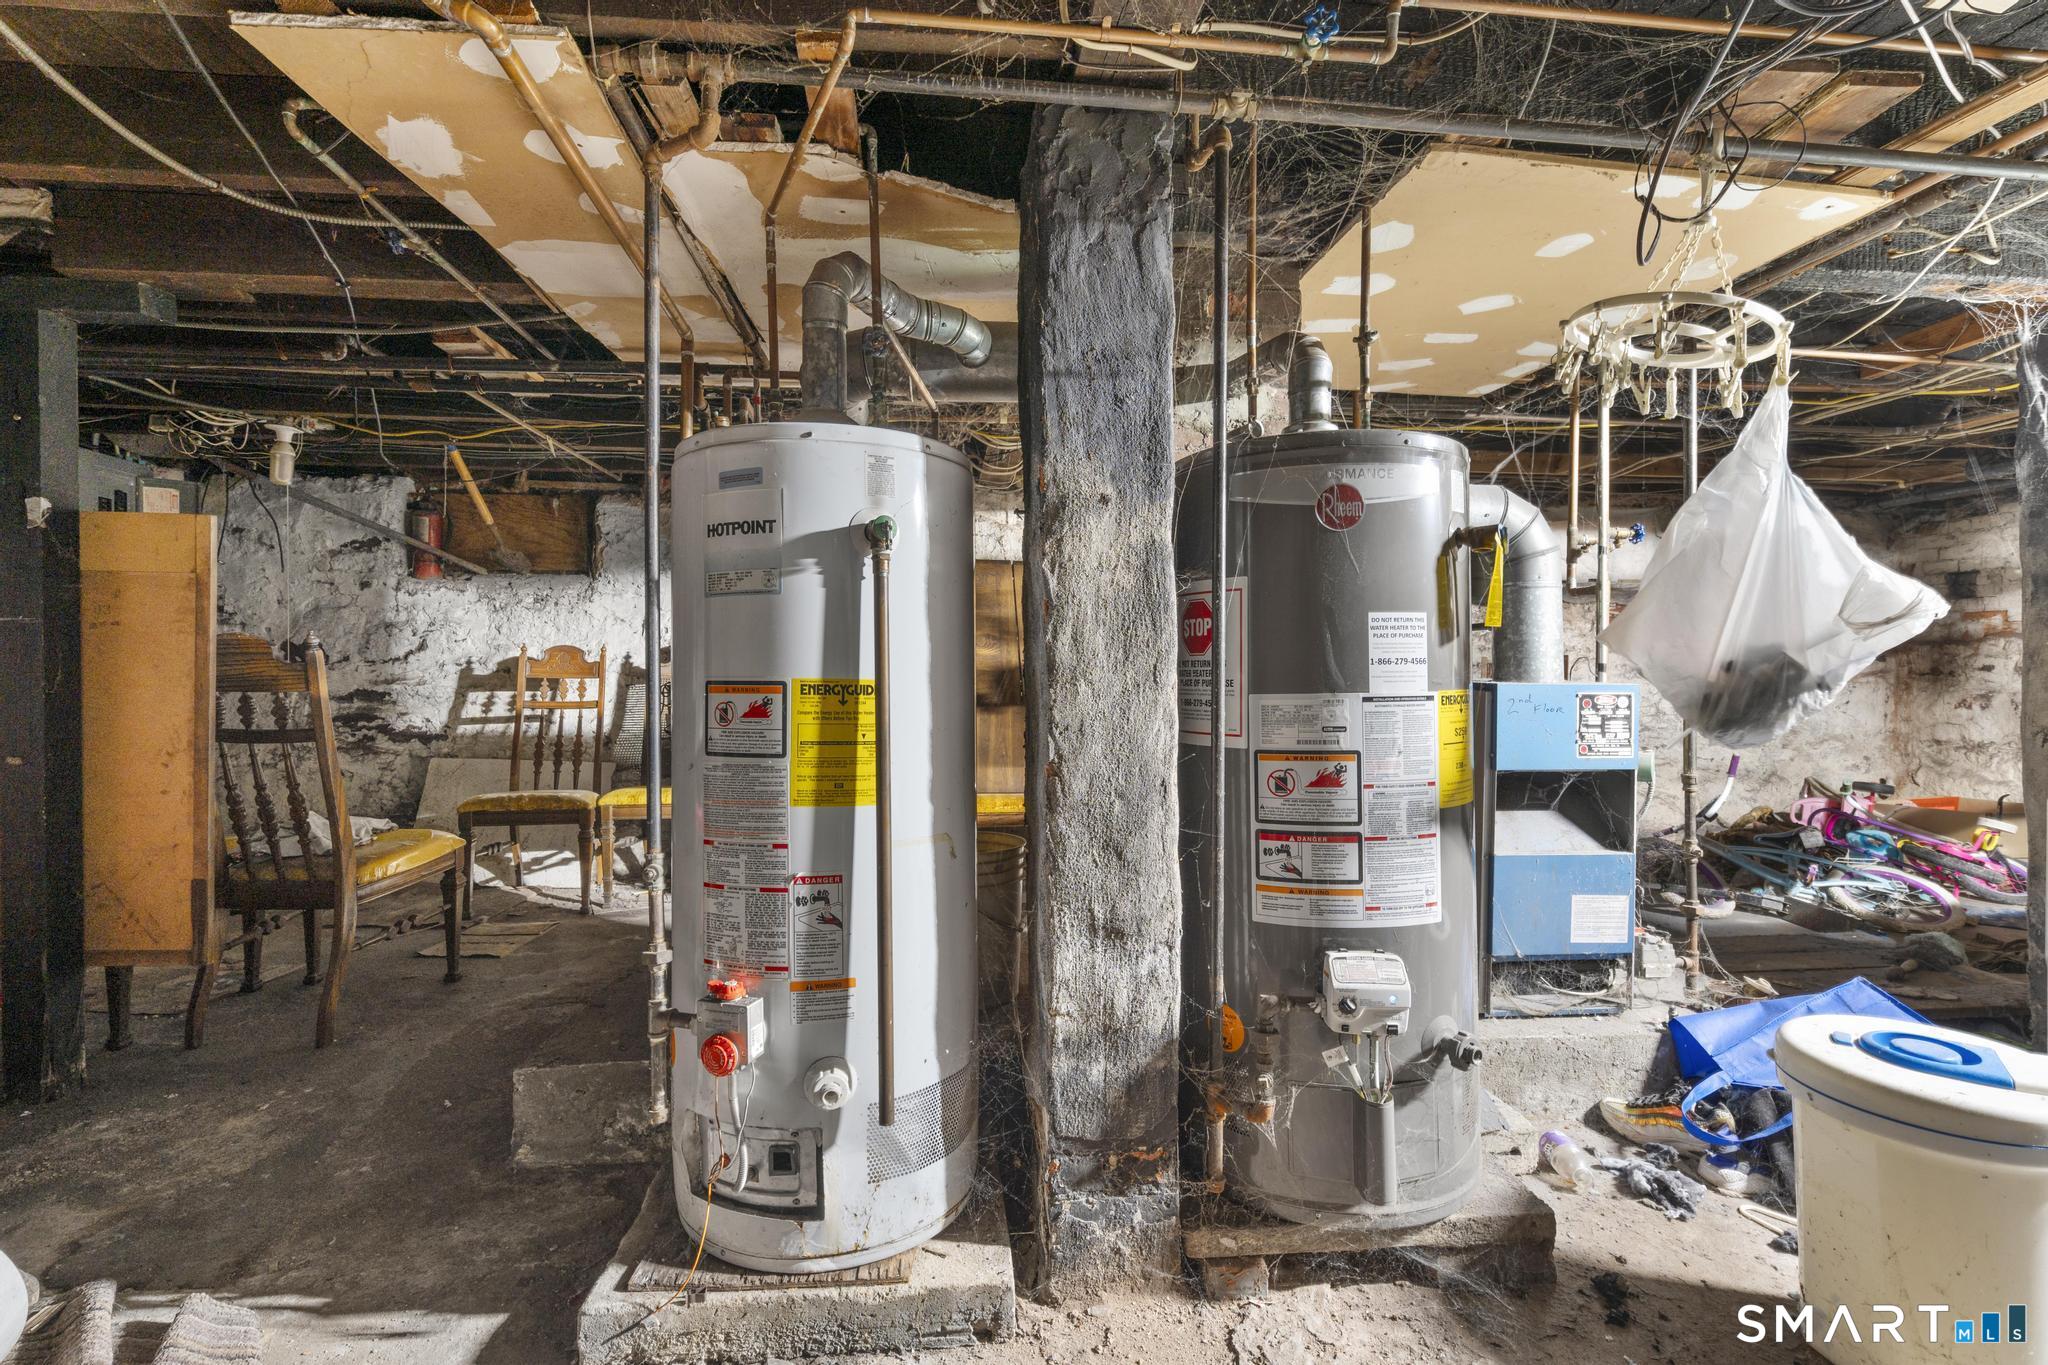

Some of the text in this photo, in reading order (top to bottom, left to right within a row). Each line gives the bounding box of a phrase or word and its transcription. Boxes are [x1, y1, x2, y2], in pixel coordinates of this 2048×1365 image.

[1322, 486, 1362, 523] Rheem
[707, 519, 776, 538] HOTPOINT
[1184, 618, 1212, 639] STOP
[1370, 657, 1427, 666] 1-866-279-4566
[1506, 693, 1532, 714] 2nd
[805, 876, 841, 884] DANGER
